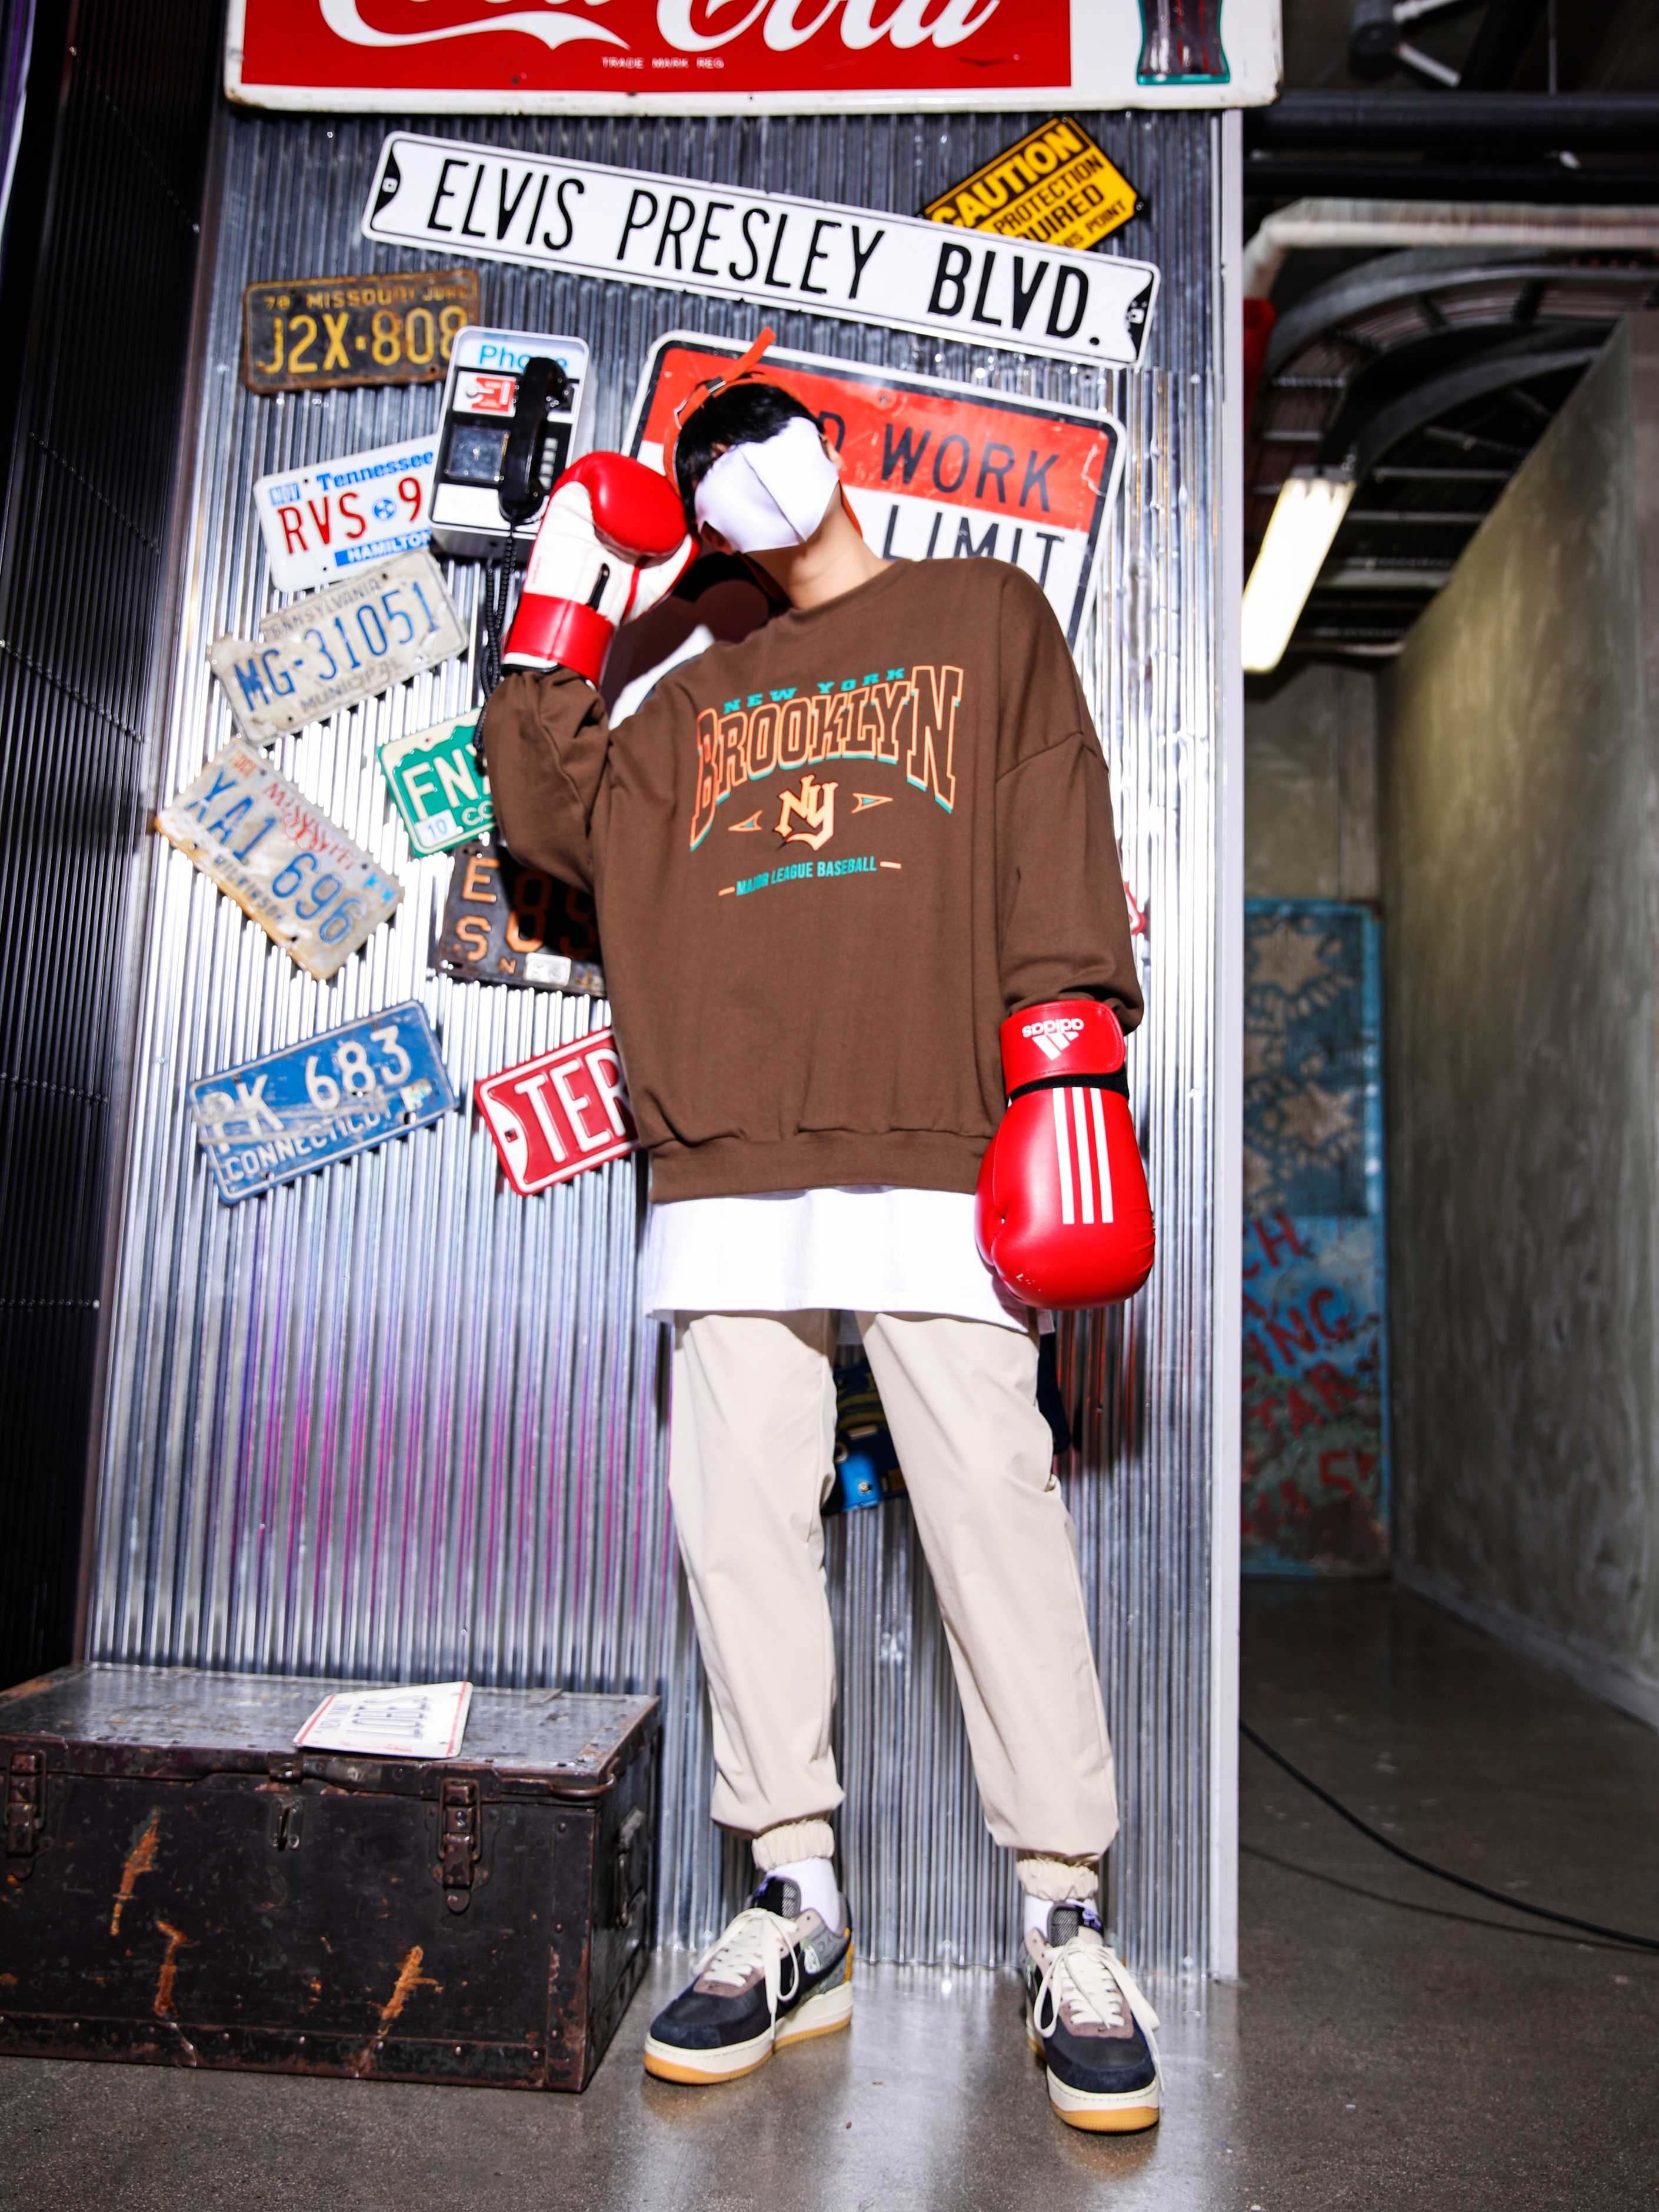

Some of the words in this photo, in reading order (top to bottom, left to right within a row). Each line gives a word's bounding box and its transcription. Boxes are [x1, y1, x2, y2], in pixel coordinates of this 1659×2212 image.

[601, 56, 645, 69] TRADE
[651, 57, 689, 69] MARK
[993, 154, 1104, 235] PROTECTION
[1085, 198, 1126, 234] POINT
[427, 158, 584, 251] ELVIS
[617, 189, 885, 299] PRESLEY
[928, 242, 1100, 346] BLVD.
[307, 287, 415, 309] MISSOURI
[317, 451, 434, 491] Tennessee
[881, 423, 1059, 511] WORK
[278, 492, 366, 554] RVS
[398, 477, 422, 522] 9
[883, 505, 1065, 590] LIMIT
[234, 581, 439, 711] MG-31051
[263, 578, 382, 641] PENNSYLVANIA
[301, 657, 400, 712] MUNICIPAL
[723, 687, 797, 714] NEW
[817, 668, 905, 694] YORK
[689, 665, 964, 852] BROOKLYN
[426, 818, 449, 839] 10
[272, 851, 368, 945] 696
[736, 871, 768, 896] MAJOR
[771, 861, 813, 885] LEAGUE
[817, 856, 877, 877] BASEBALL
[1021, 1018, 1085, 1038] adidas
[202, 1074, 285, 1154] PK
[305, 1025, 412, 1111] 683
[514, 1048, 634, 1163] TER
[224, 1107, 393, 1182] CONNECTICUT
